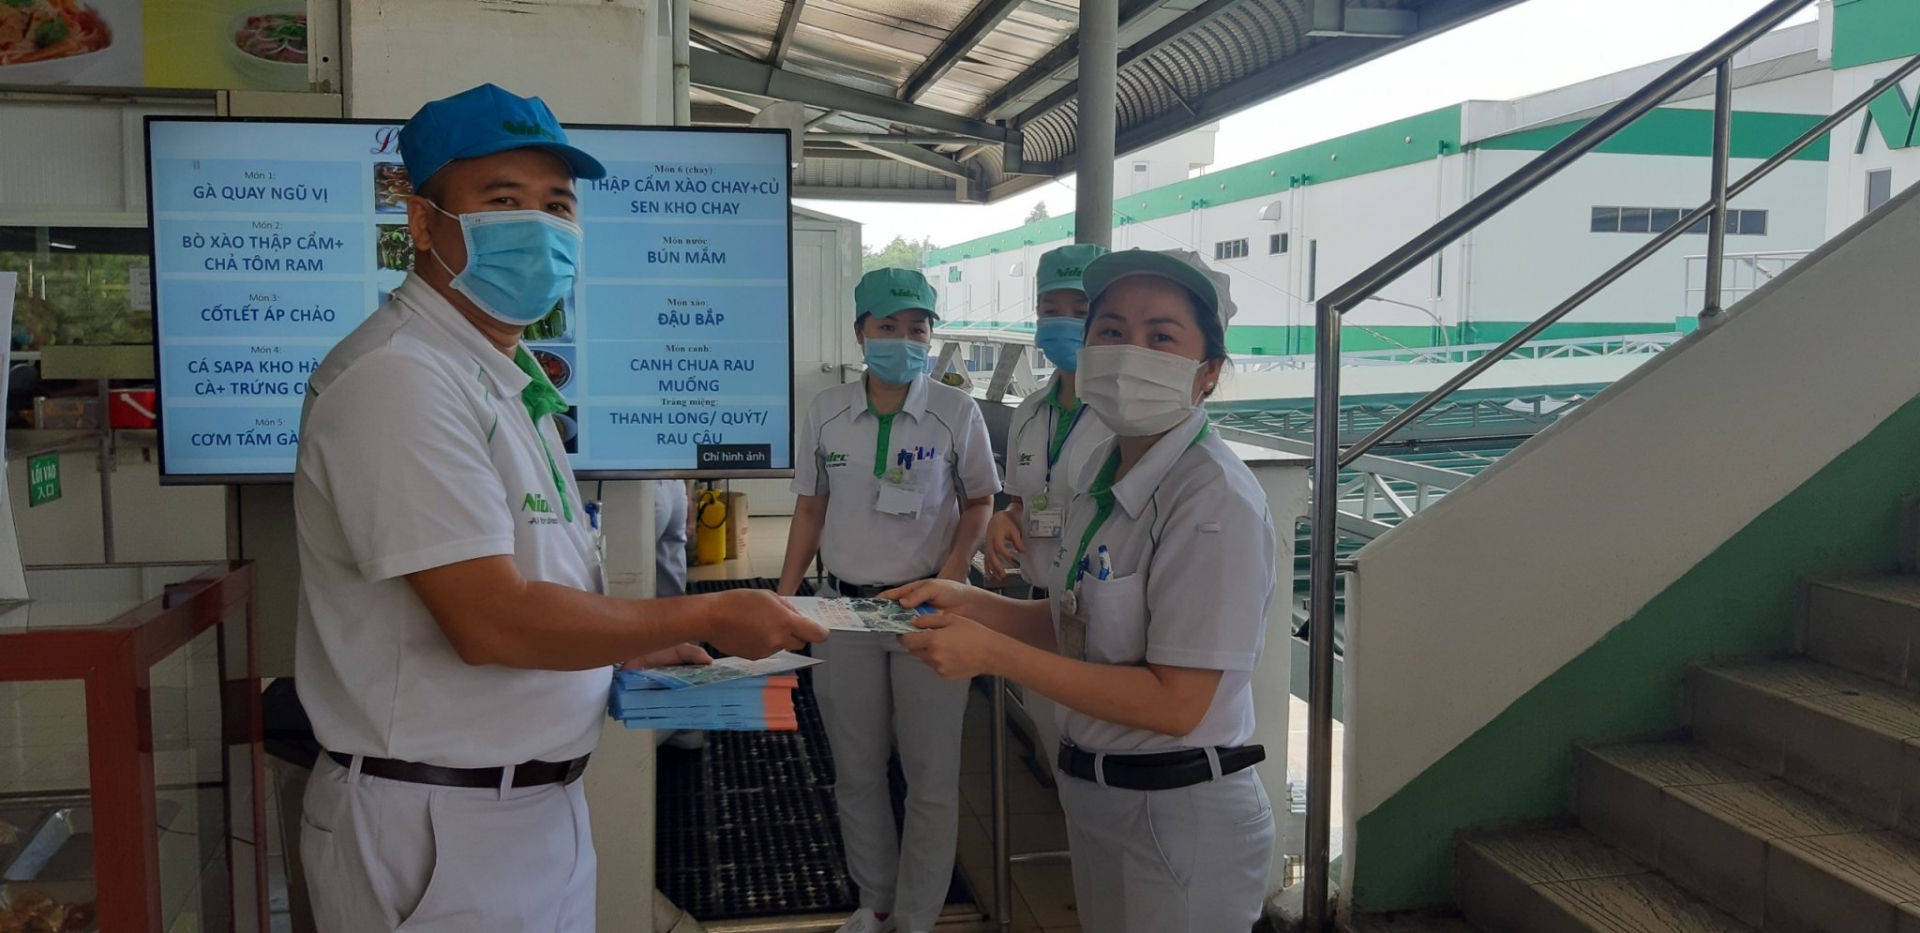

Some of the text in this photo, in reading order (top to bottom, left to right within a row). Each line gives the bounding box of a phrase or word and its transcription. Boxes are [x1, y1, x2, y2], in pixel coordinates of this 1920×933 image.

[244, 170, 276, 180] Món 1:
[654, 165, 676, 174] Món
[591, 174, 780, 195] THẬP CẨM XÀO CHAY+CỦ
[193, 182, 328, 203] GÀ QUAY NGŨ VỊ
[631, 200, 741, 215] SEN KHO CHAY
[251, 220, 283, 230] Món 2:
[182, 231, 344, 251] BÒ XÀO THẬP CẨM+
[662, 236, 684, 245] Món
[204, 253, 324, 271] CHẢ TÔM RAM
[647, 247, 726, 264] BÚN MẮM
[249, 293, 280, 302] Món 3:
[667, 299, 688, 307] Món
[201, 304, 336, 322] CỐTLẾT ÁP CHẢO
[657, 309, 725, 328] ĐẬU BẮP
[250, 345, 282, 354] Món 4:
[665, 345, 686, 353] Món
[188, 357, 210, 373] CÁ
[213, 361, 254, 373] SAPA
[259, 361, 294, 373] KHO
[630, 359, 755, 372] CANH CHUA RAU
[194, 379, 226, 395] CÀ+
[230, 379, 288, 395] TRỨNG
[658, 376, 720, 392] MUỐNG
[255, 418, 286, 427] Món 5:
[609, 409, 768, 426] THANH LONG/ QUÝT/
[191, 429, 299, 447] CƠM TẤM GÀ
[657, 430, 723, 445] RAU CÂU
[722, 451, 744, 461] hình
[746, 451, 765, 461] ảnh
[37, 483, 54, 500] 入口
